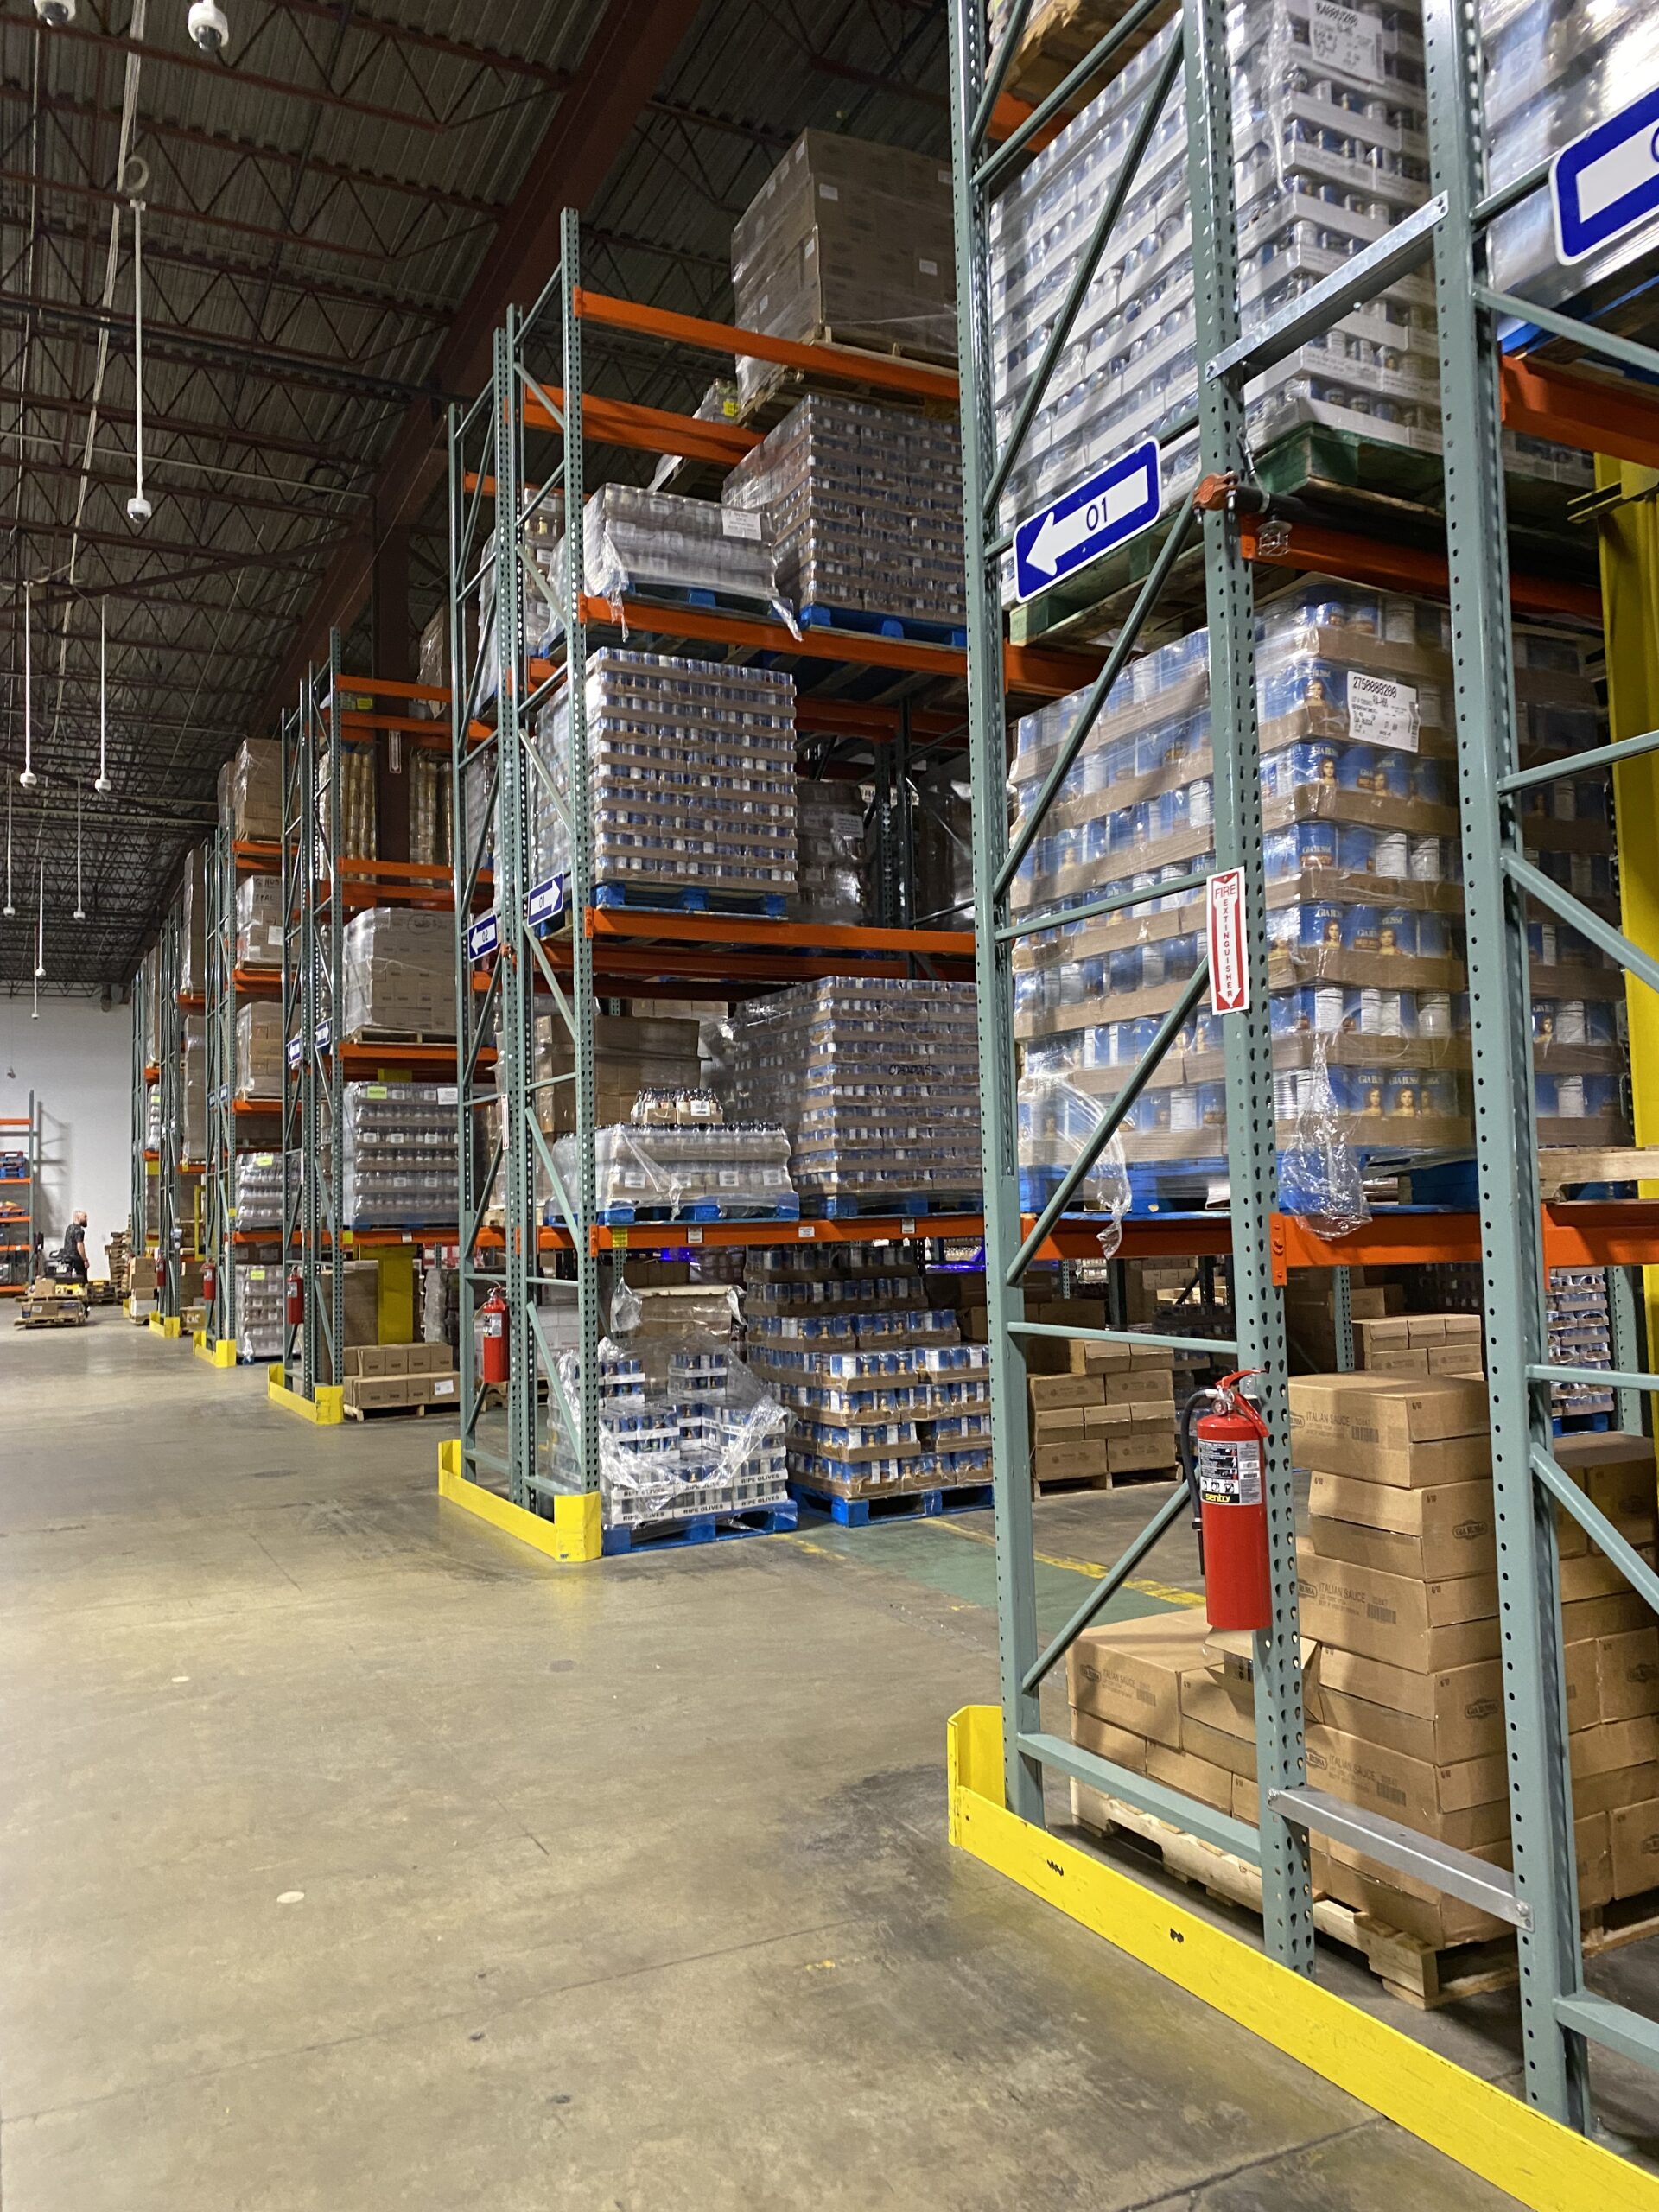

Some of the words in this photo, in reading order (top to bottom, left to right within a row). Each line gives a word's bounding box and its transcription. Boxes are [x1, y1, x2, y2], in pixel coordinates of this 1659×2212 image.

[1086, 497, 1108, 531] 01
[1215, 885, 1236, 899] FIRE
[1223, 899, 1233, 997] EXTINGUISHER
[1306, 1411, 1329, 1425] ITALIAN
[1205, 1493, 1231, 1503] sentry
[701, 1503, 723, 1512] OLIVES
[1319, 1582, 1344, 1598] ITALIAN
[1344, 1590, 1366, 1604] SAUCE
